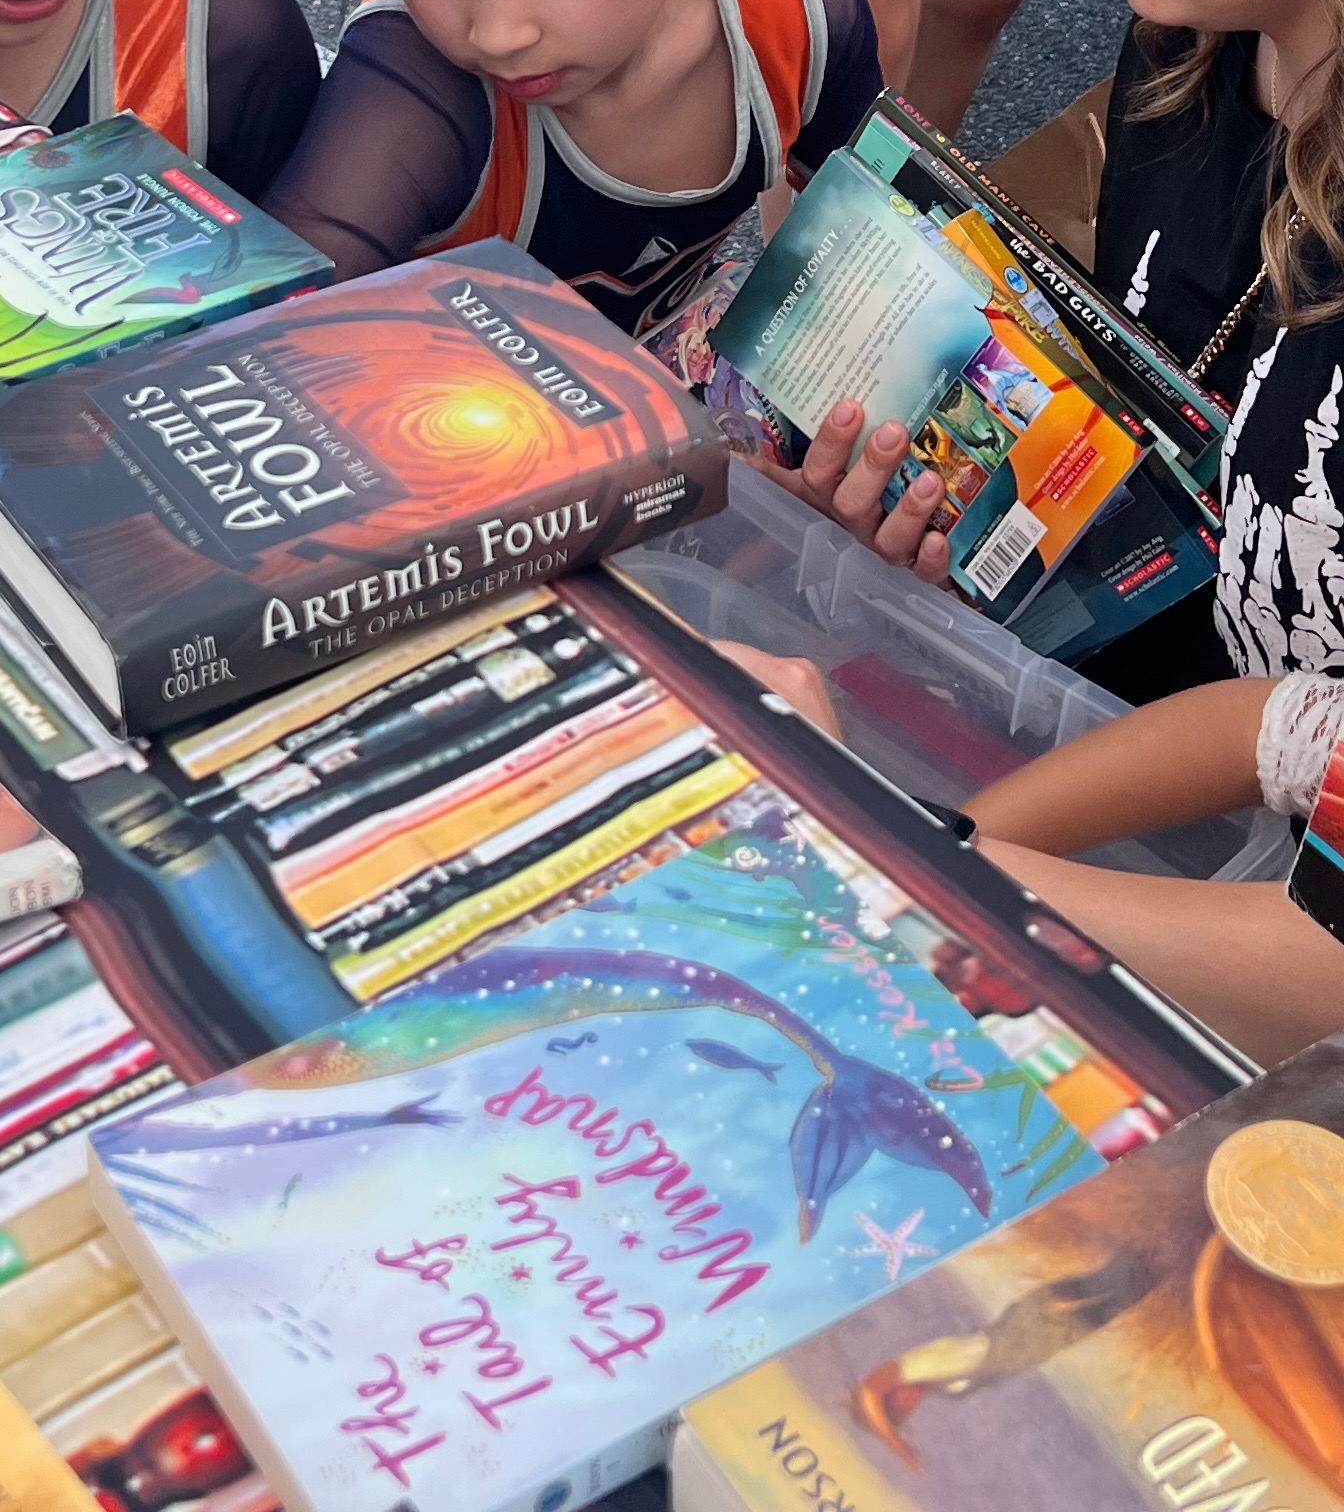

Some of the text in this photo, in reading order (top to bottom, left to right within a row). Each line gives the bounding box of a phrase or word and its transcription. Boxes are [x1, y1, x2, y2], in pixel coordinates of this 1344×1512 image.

[93, 174, 213, 263] FIRE
[132, 171, 224, 235] THE POISON JUNGLE
[163, 170, 229, 215] SCHOLASTIC
[895, 96, 1055, 246] BONE OLD MAN'S CAVE
[752, 273, 809, 357] A QUESTION OF
[1009, 238, 1118, 343] the BAD GUYS
[447, 283, 607, 420] EOIN COLFER
[123, 385, 287, 536] ARTEMIS
[194, 360, 355, 517] FOWL
[232, 351, 385, 488] THE OPAL DECEPTION
[1053, 446, 1097, 496] SCHOLASTIC
[623, 474, 686, 506] HYPERION
[634, 487, 687, 514] miramax
[634, 503, 674, 524] books
[261, 498, 601, 649] ARTEMIS FOWL
[309, 546, 571, 661] THE OPAL DECEPTION
[1121, 551, 1172, 593] SCHOLASTIC
[161, 656, 238, 702] COLFER
[172, 632, 219, 672] EOIN
[815, 912, 930, 1036] Kessler
[482, 1065, 772, 1314] Windsnap
[488, 1171, 667, 1378] Emily
[375, 1232, 555, 1432] Tail of
[338, 1352, 448, 1488] The
